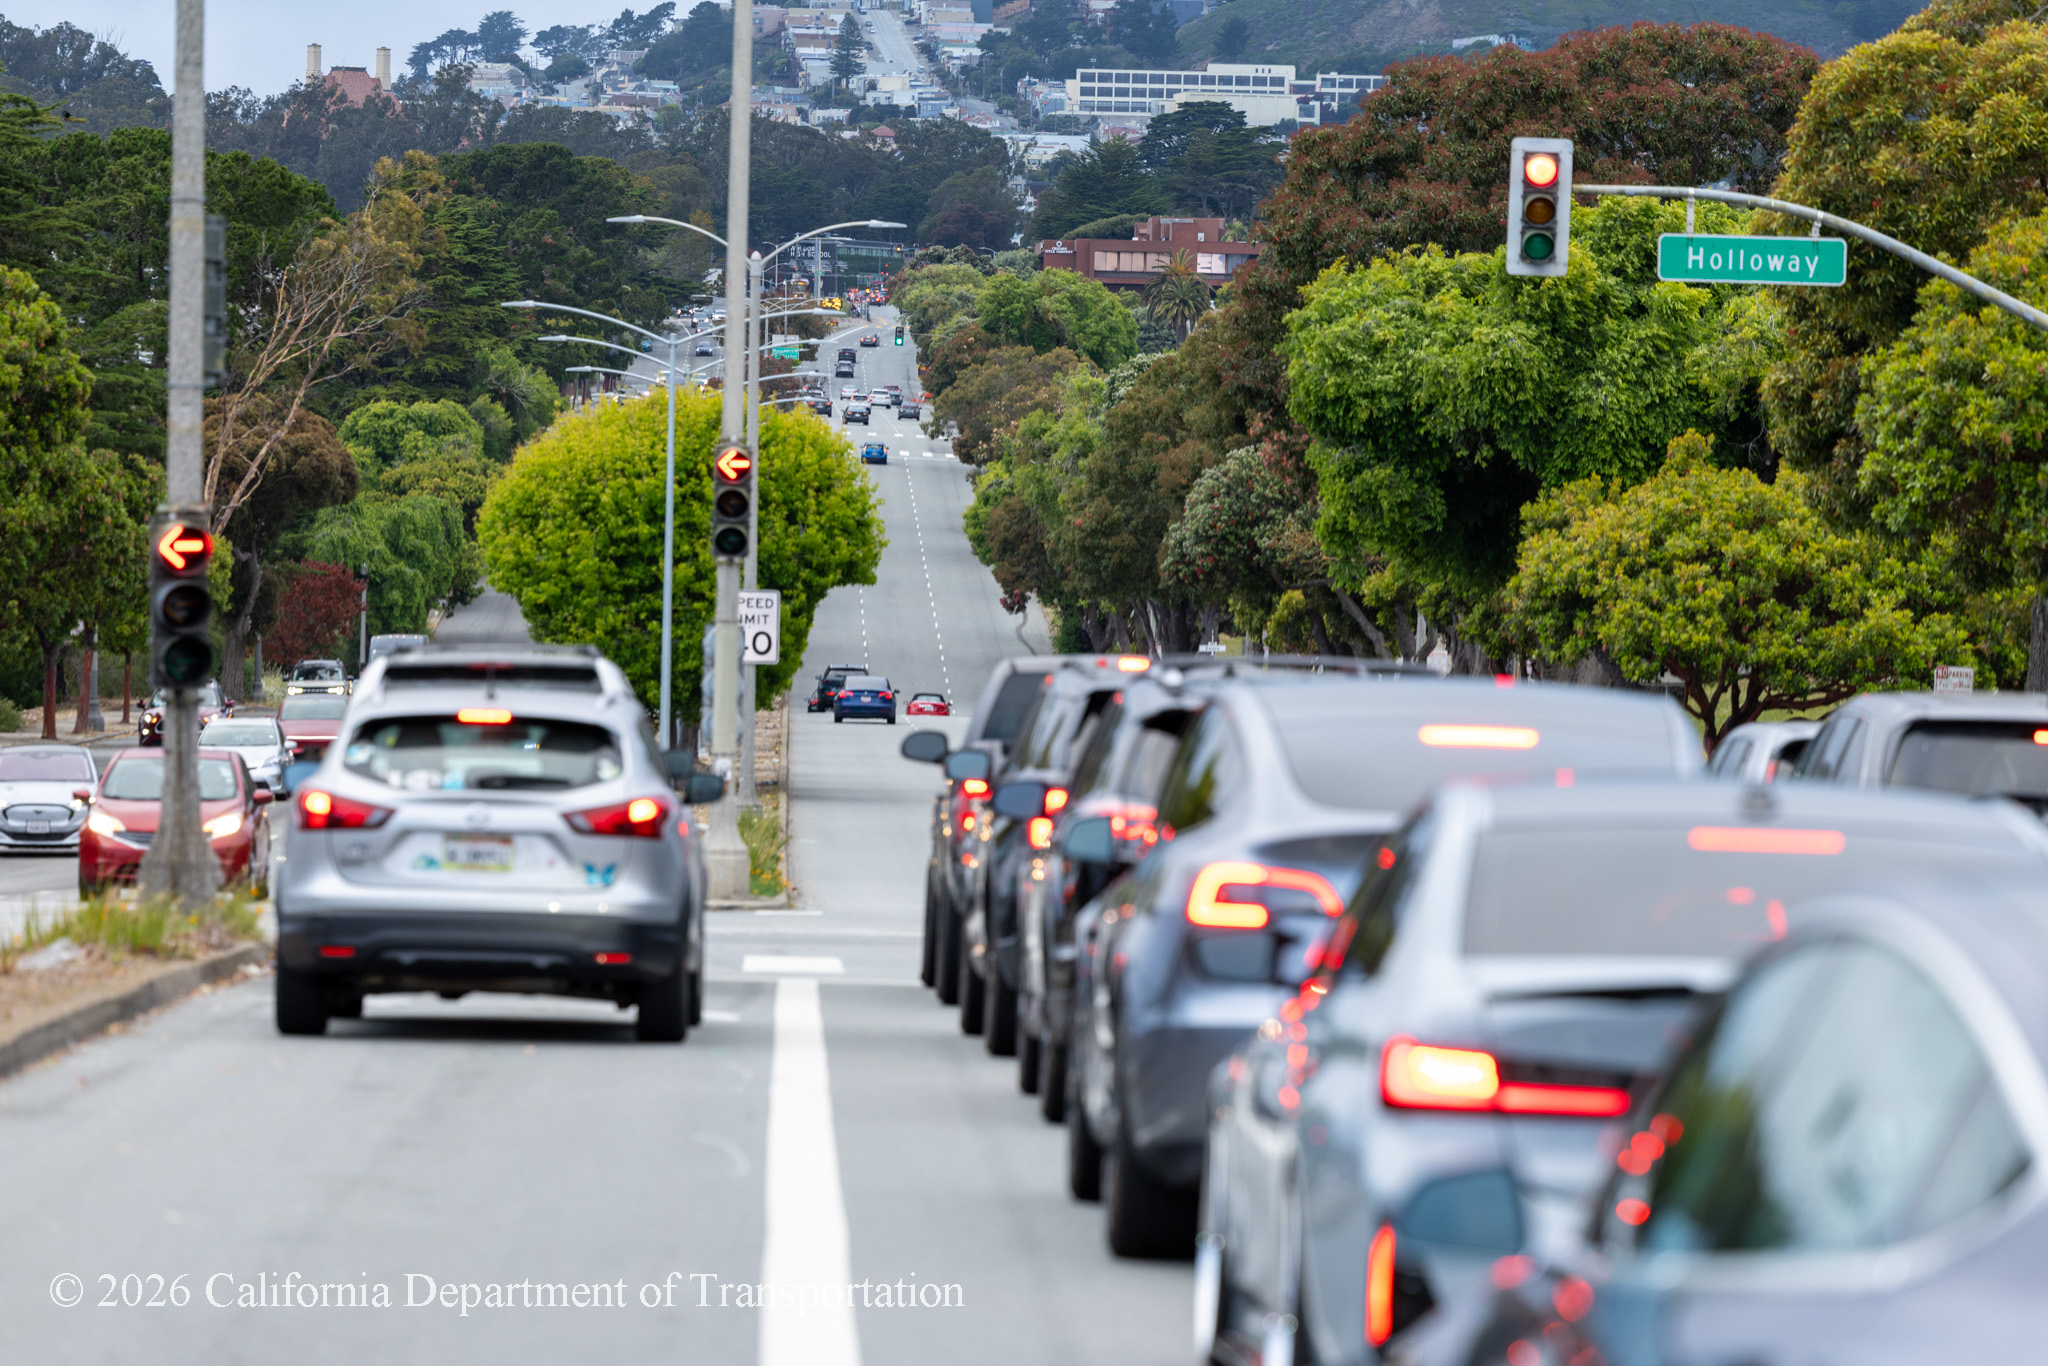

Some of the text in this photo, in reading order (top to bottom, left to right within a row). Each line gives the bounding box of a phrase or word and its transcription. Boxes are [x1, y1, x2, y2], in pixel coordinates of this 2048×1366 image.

[1687, 246, 1819, 279] Holloway
[738, 597, 774, 609] PEED
[739, 614, 769, 625] IMIT
[745, 631, 772, 656] 0
[1937, 667, 1972, 680] NO PARKING
